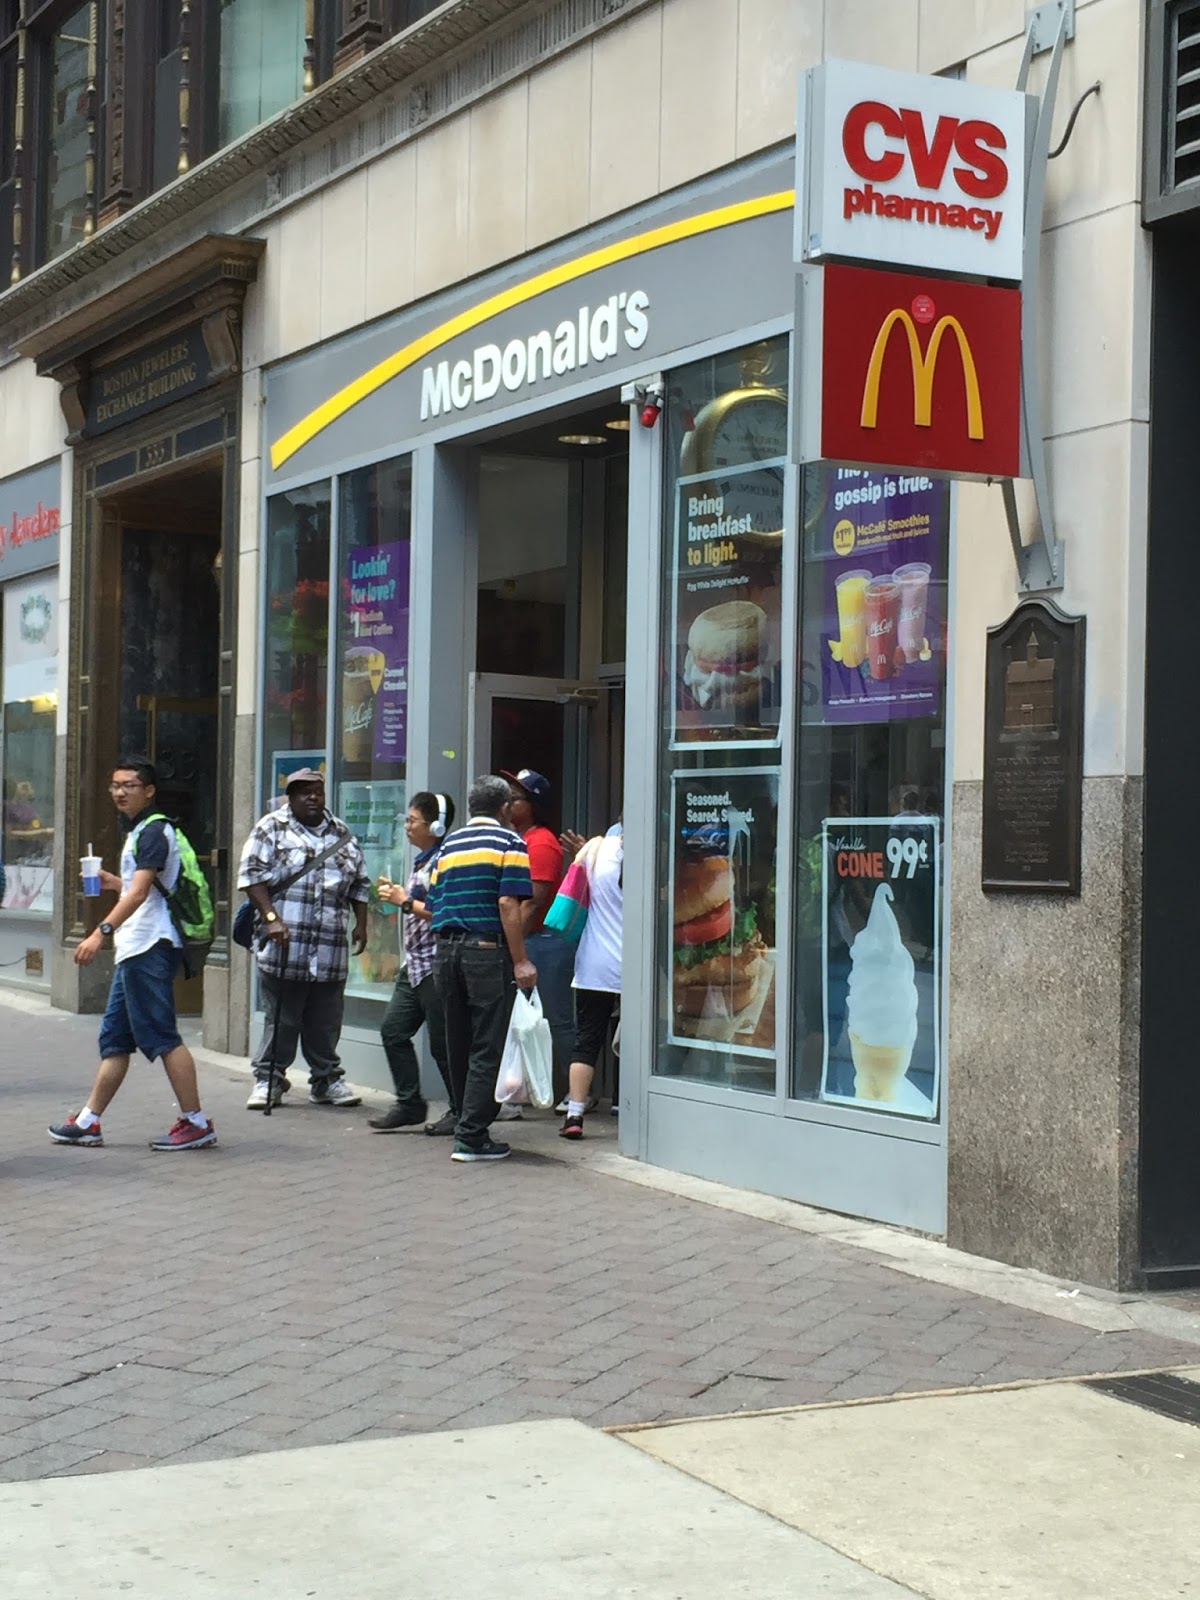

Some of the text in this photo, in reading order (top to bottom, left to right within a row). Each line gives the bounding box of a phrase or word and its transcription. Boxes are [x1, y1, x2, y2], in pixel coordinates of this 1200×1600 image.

[842, 101, 1008, 199] CVS
[843, 184, 1003, 240] pharmacy
[420, 290, 650, 421] McDonald's
[97, 362, 197, 423] EXCHANGE BUILDING
[688, 493, 724, 517] Bring
[834, 476, 933, 511] gossip is true.
[688, 513, 752, 542] breakfast
[888, 514, 930, 531] Smoothies
[687, 541, 738, 567] to light.
[367, 579, 396, 602] love?
[686, 791, 732, 806] Seasoned.
[686, 808, 755, 823] Seared. Sed.
[835, 836, 867, 851] Vanilla
[837, 851, 885, 878] CONE
